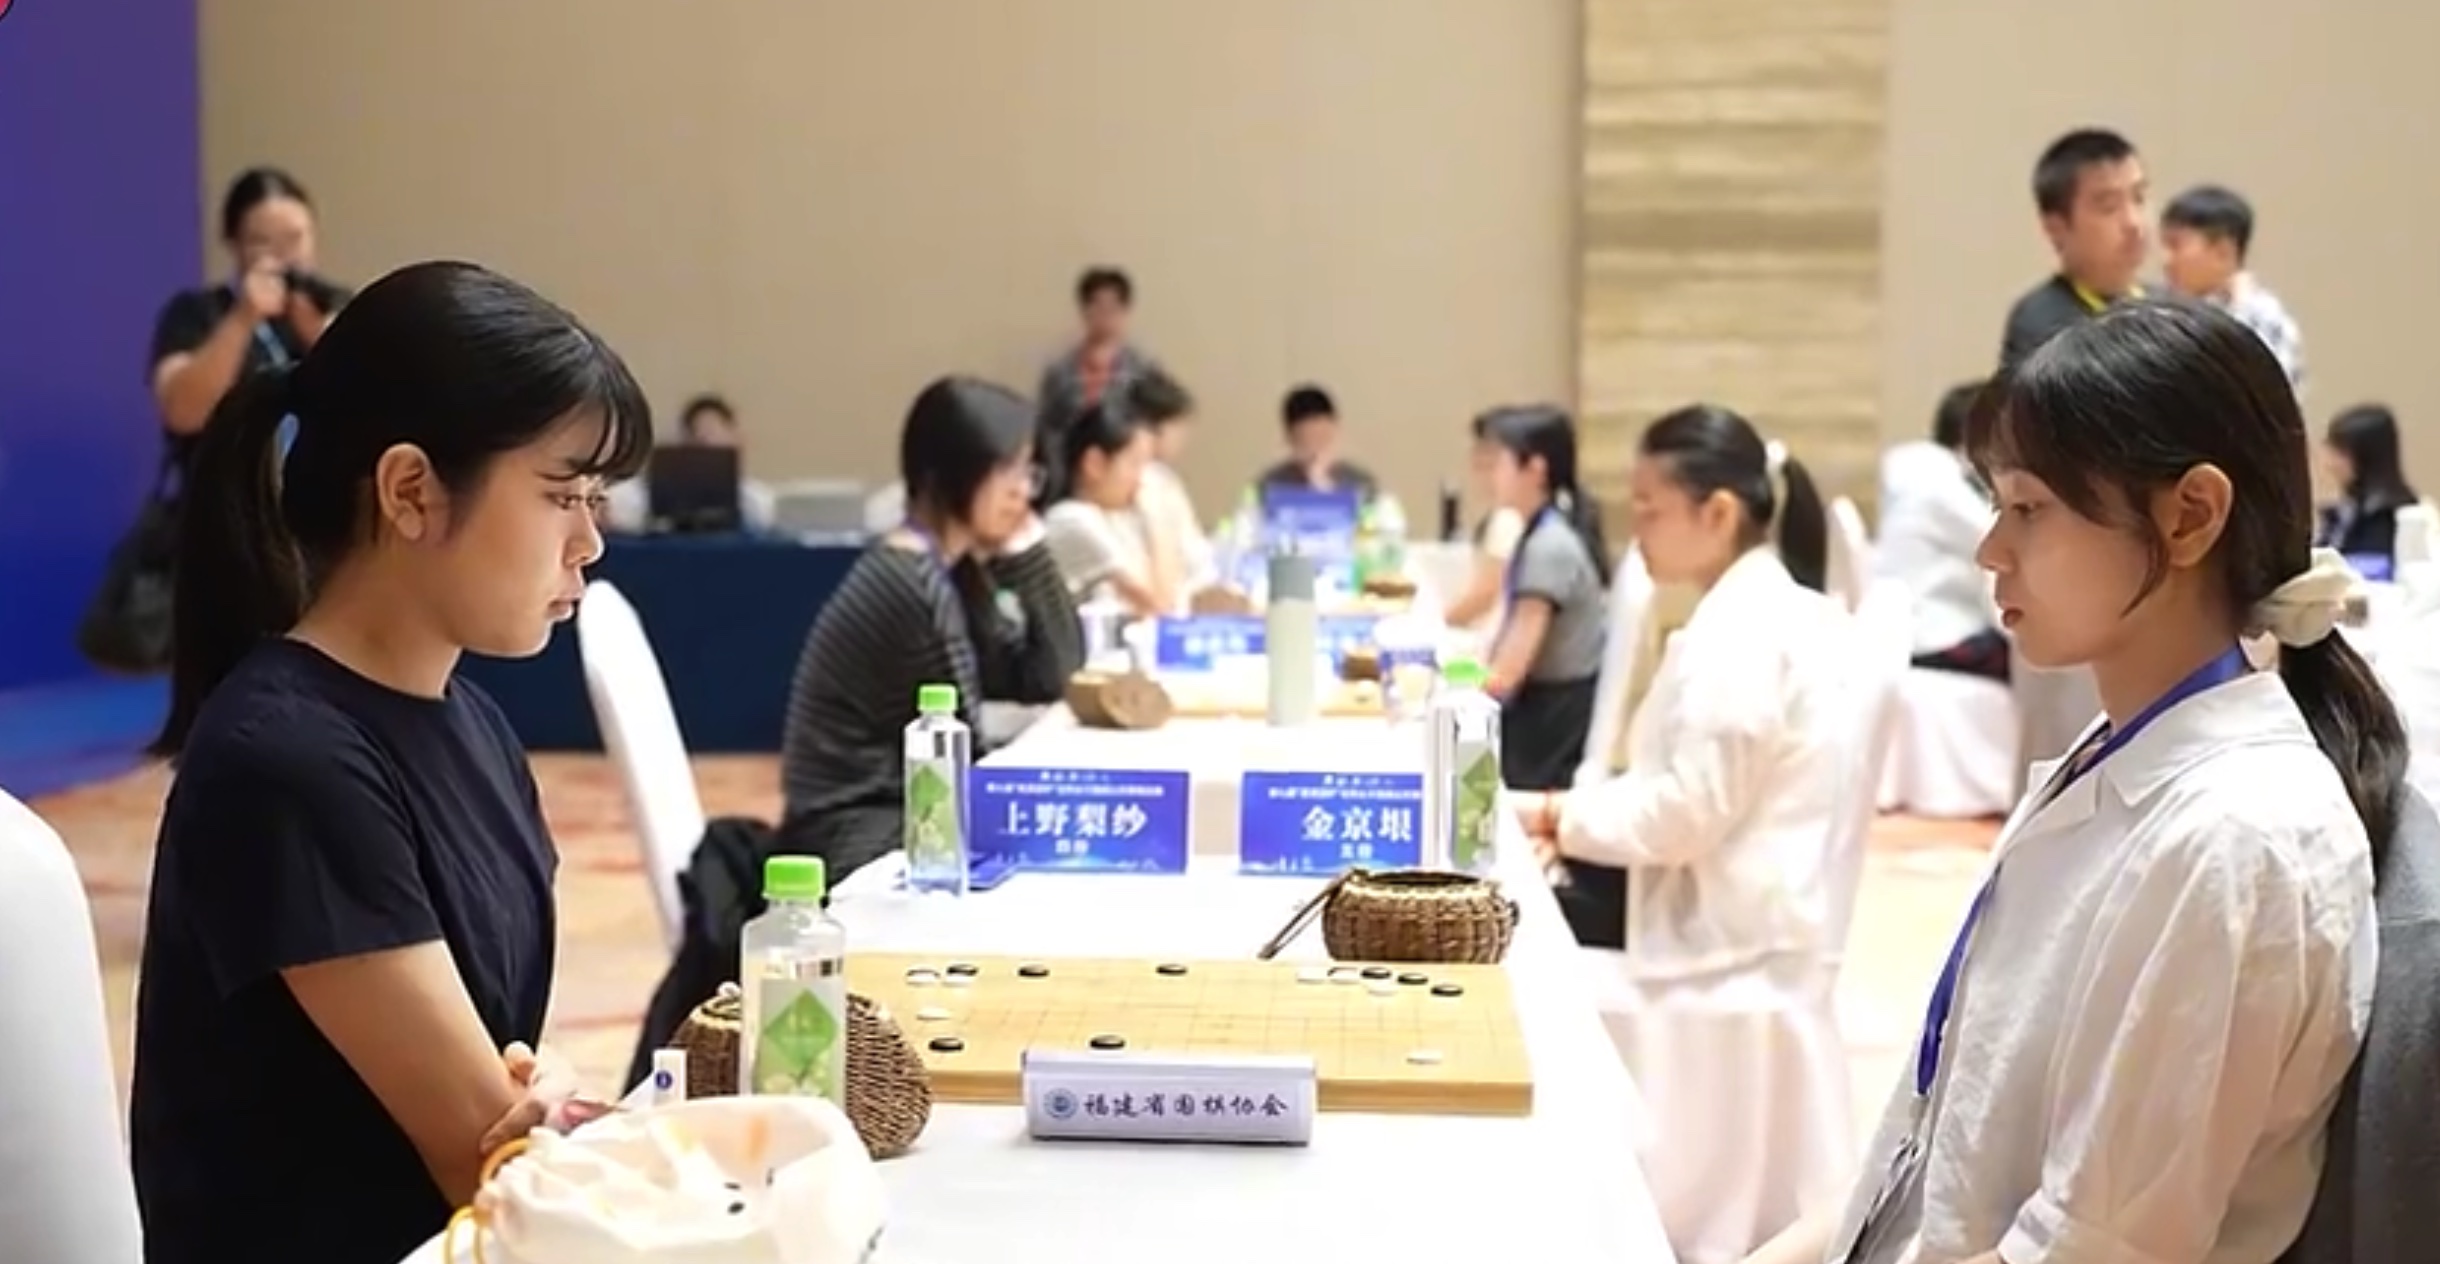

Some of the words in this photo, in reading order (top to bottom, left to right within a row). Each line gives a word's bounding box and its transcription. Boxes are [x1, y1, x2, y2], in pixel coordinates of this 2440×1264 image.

[997, 801, 1148, 838] 上野梨纱
[1301, 805, 1413, 842] 金京垠
[1084, 1092, 1289, 1118] 福建省围棋协会
